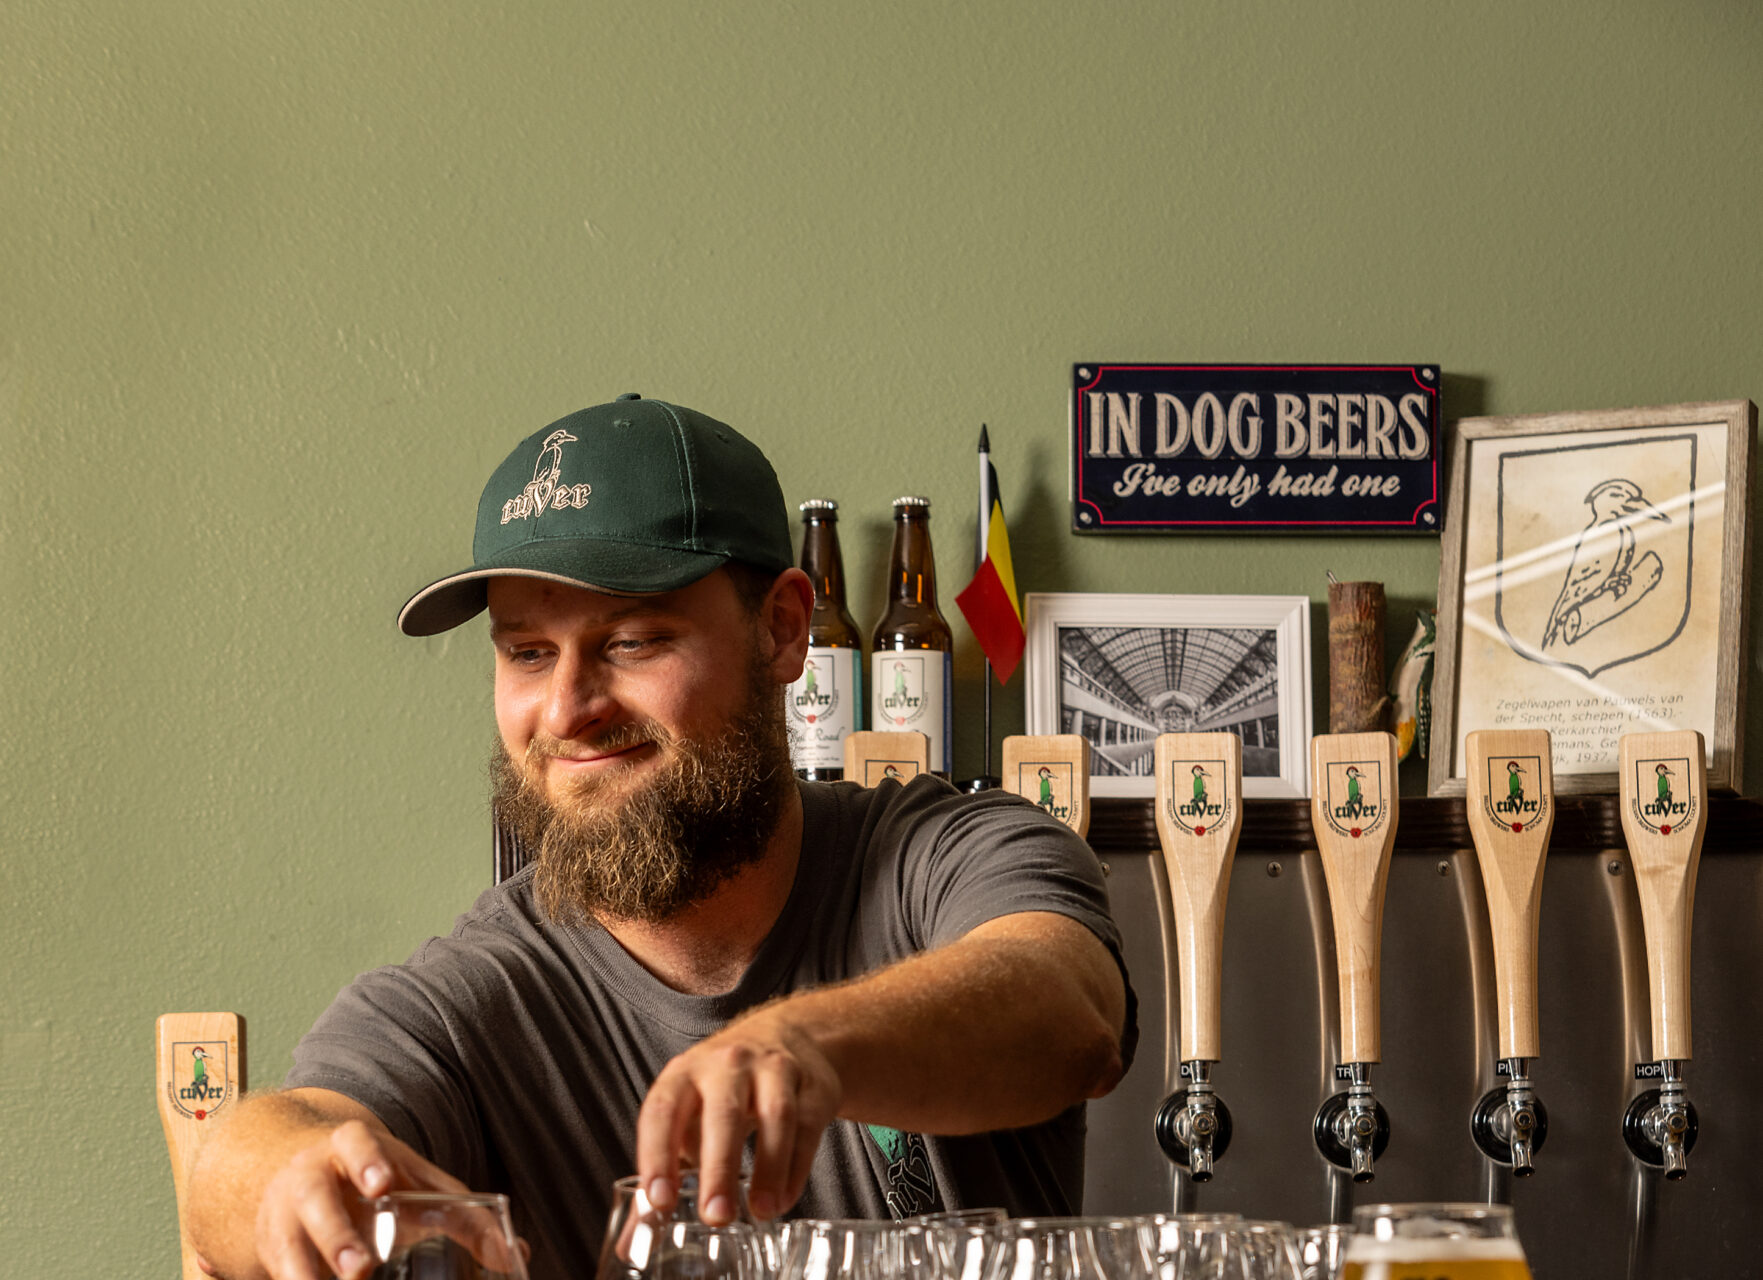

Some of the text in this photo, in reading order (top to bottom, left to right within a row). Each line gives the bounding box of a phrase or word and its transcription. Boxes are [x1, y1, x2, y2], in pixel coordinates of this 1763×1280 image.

[1088, 391, 1431, 460] IN DOG BEERS
[1113, 463, 1400, 508] I've only had one
[1496, 693, 1684, 712] Zegelwapen van Pauwels van
[1495, 714, 1515, 724] der
[1520, 711, 1566, 724] Specht,
[1571, 710, 1624, 722] schepen
[1600, 737, 1619, 749] Ge
